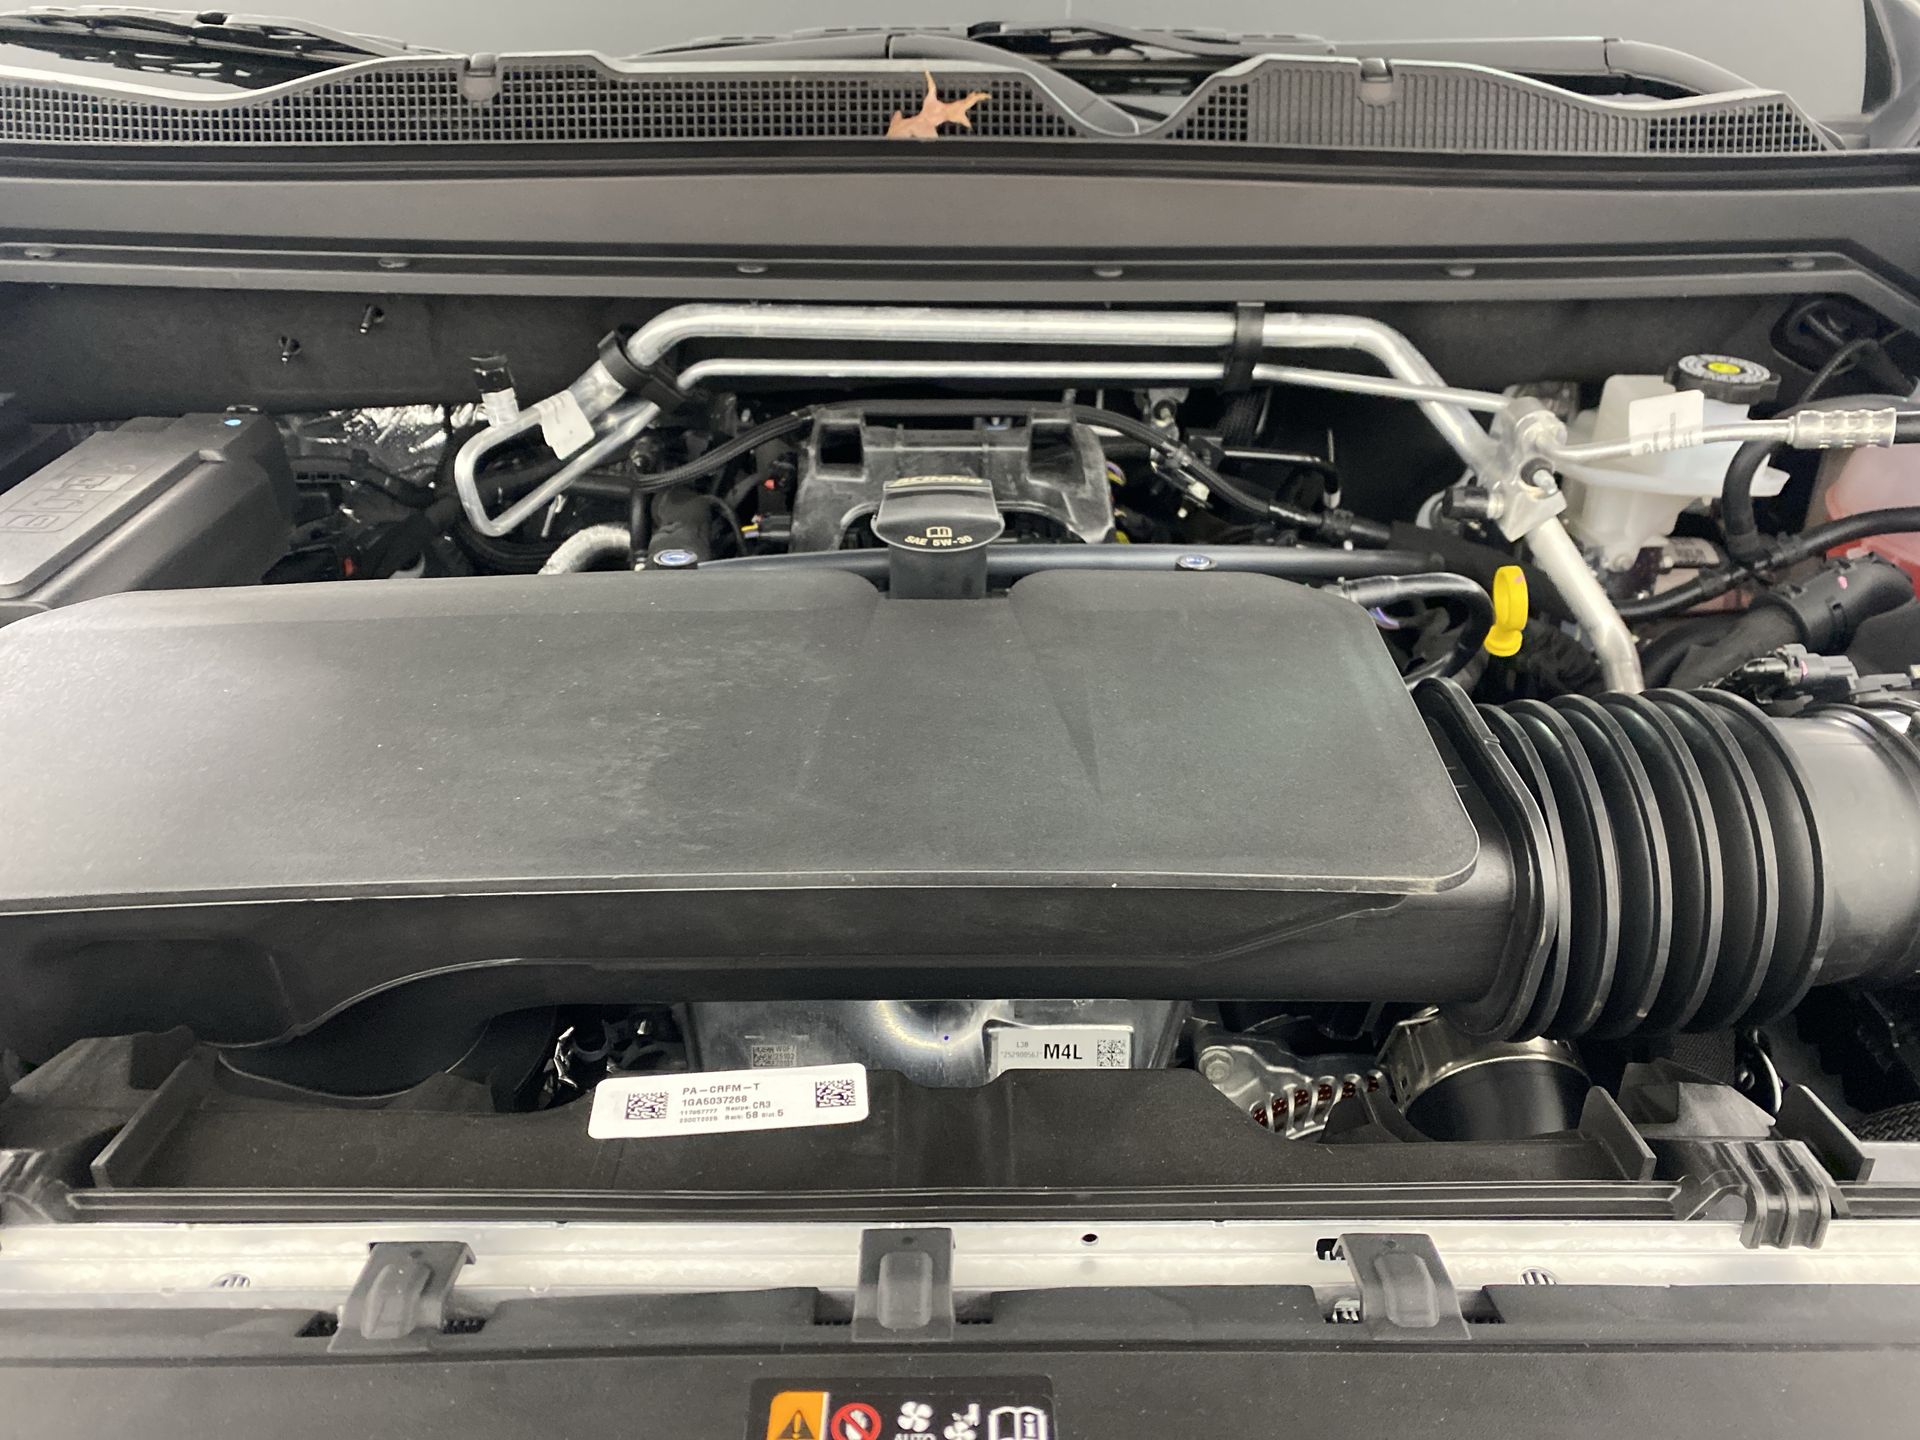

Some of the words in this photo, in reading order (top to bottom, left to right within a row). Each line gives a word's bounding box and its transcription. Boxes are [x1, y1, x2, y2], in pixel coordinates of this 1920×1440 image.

[904, 535, 928, 545] SAE
[932, 535, 973, 546] 5W-30
[1044, 1044, 1083, 1060] M4L
[752, 1101, 771, 1109] CR3
